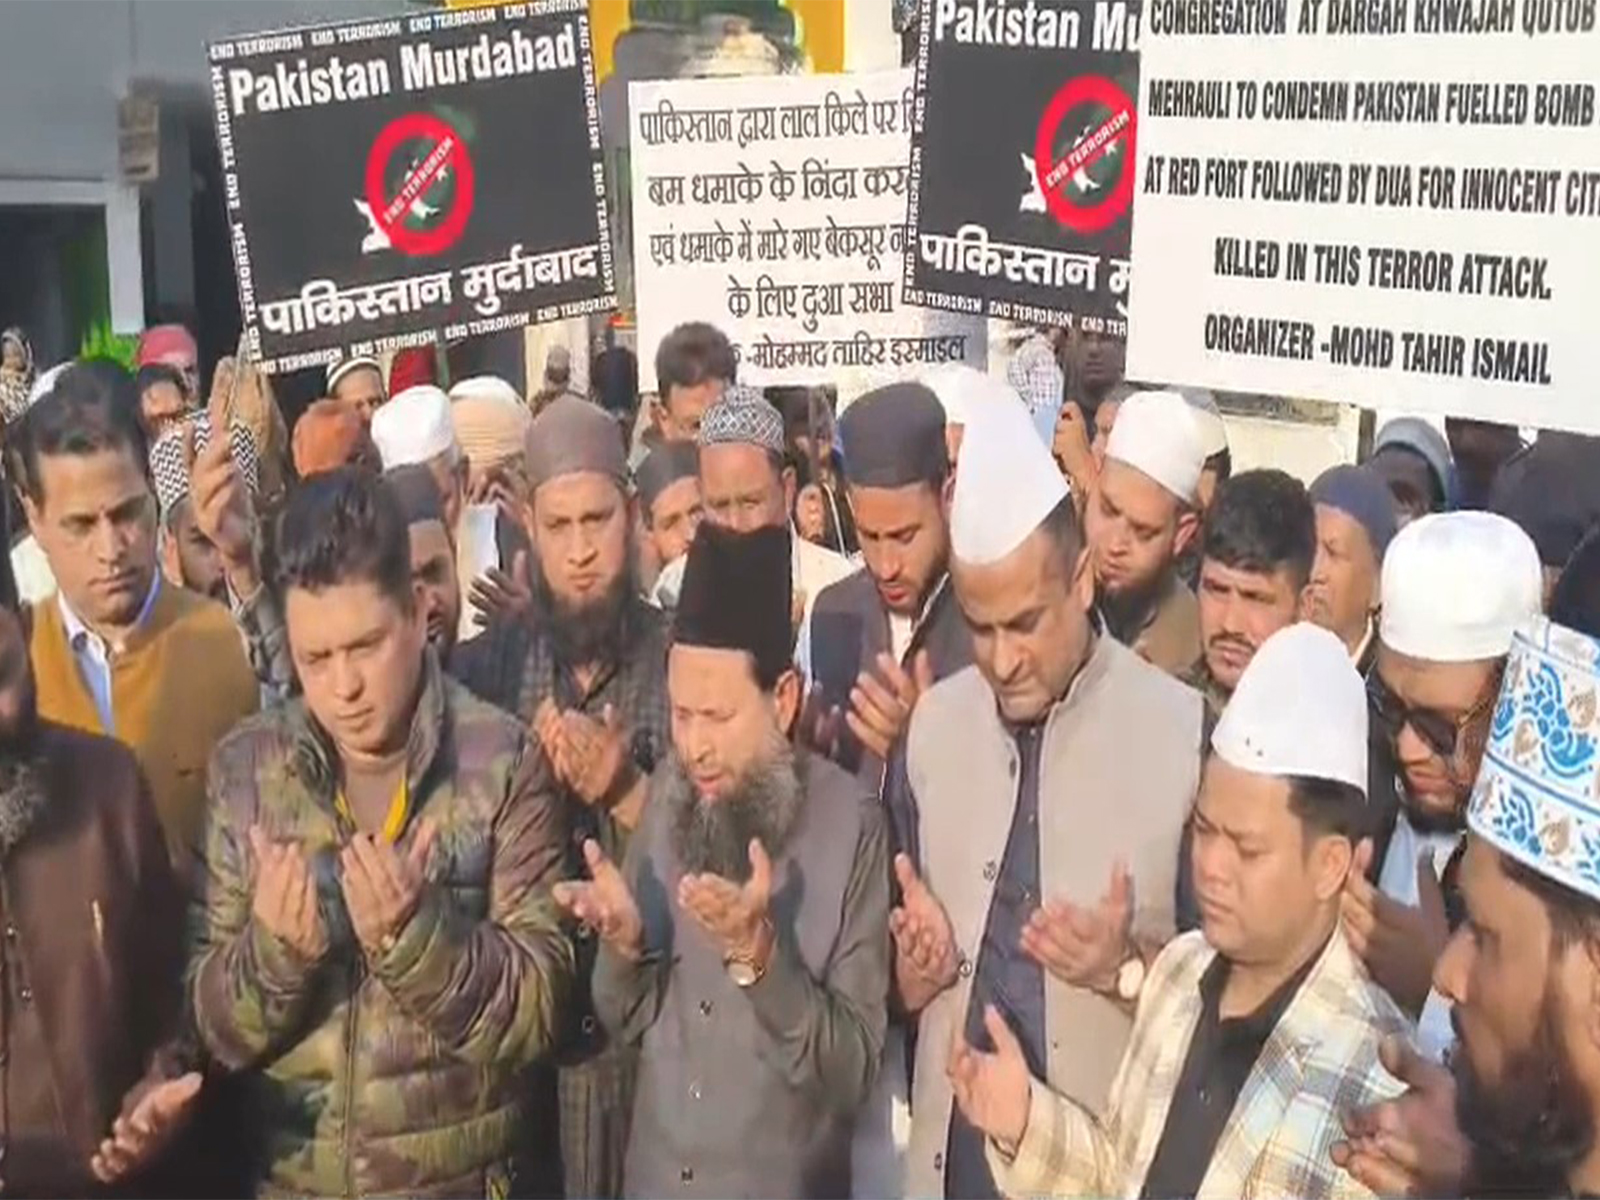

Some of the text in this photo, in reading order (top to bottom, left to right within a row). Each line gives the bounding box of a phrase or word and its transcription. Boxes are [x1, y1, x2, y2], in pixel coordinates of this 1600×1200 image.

[917, 0, 931, 91] TERRORIS
[932, 0, 1142, 52] Pakistan Mu
[1150, 0, 1596, 39] CONGREGATION AT DARGAH KHWAJAH QUTUB
[228, 24, 577, 117] Pakistan Murdabad
[639, 98, 734, 145] पाकिस्तान
[736, 107, 777, 149] द्वारा
[779, 104, 821, 138] लाल
[824, 90, 869, 136] किले
[871, 100, 898, 134] पर
[1148, 79, 1596, 126] MEHRAULI TO CONDEMN PAKISTAN FUELLED BOMB
[647, 175, 686, 207] बम
[691, 161, 764, 205] धमाके
[768, 160, 797, 202] के
[801, 157, 859, 201] निंदा
[1143, 156, 1600, 217] AT RED FORT FOLLOWED BY DUA FOR INNOCENT CIT
[649, 223, 676, 266] एवं
[680, 219, 734, 263] धमाके
[737, 218, 754, 262] में
[757, 218, 789, 261] मारे
[791, 228, 822, 262] गए
[825, 215, 887, 271] बेकसूर
[919, 223, 1100, 292] पाकिस्तान
[1214, 237, 1552, 300] KILLED IN THIS TERROR ATTACK.
[259, 244, 600, 334] पाकिस्तान मुर्दाबाद
[727, 274, 895, 334] के लिए दुआ सभा
[832, 330, 888, 367] ताहिर
[1106, 319, 1128, 337] TER
[1204, 313, 1552, 385] ORGANIZER -MOHD TAHIR ISMAIL
